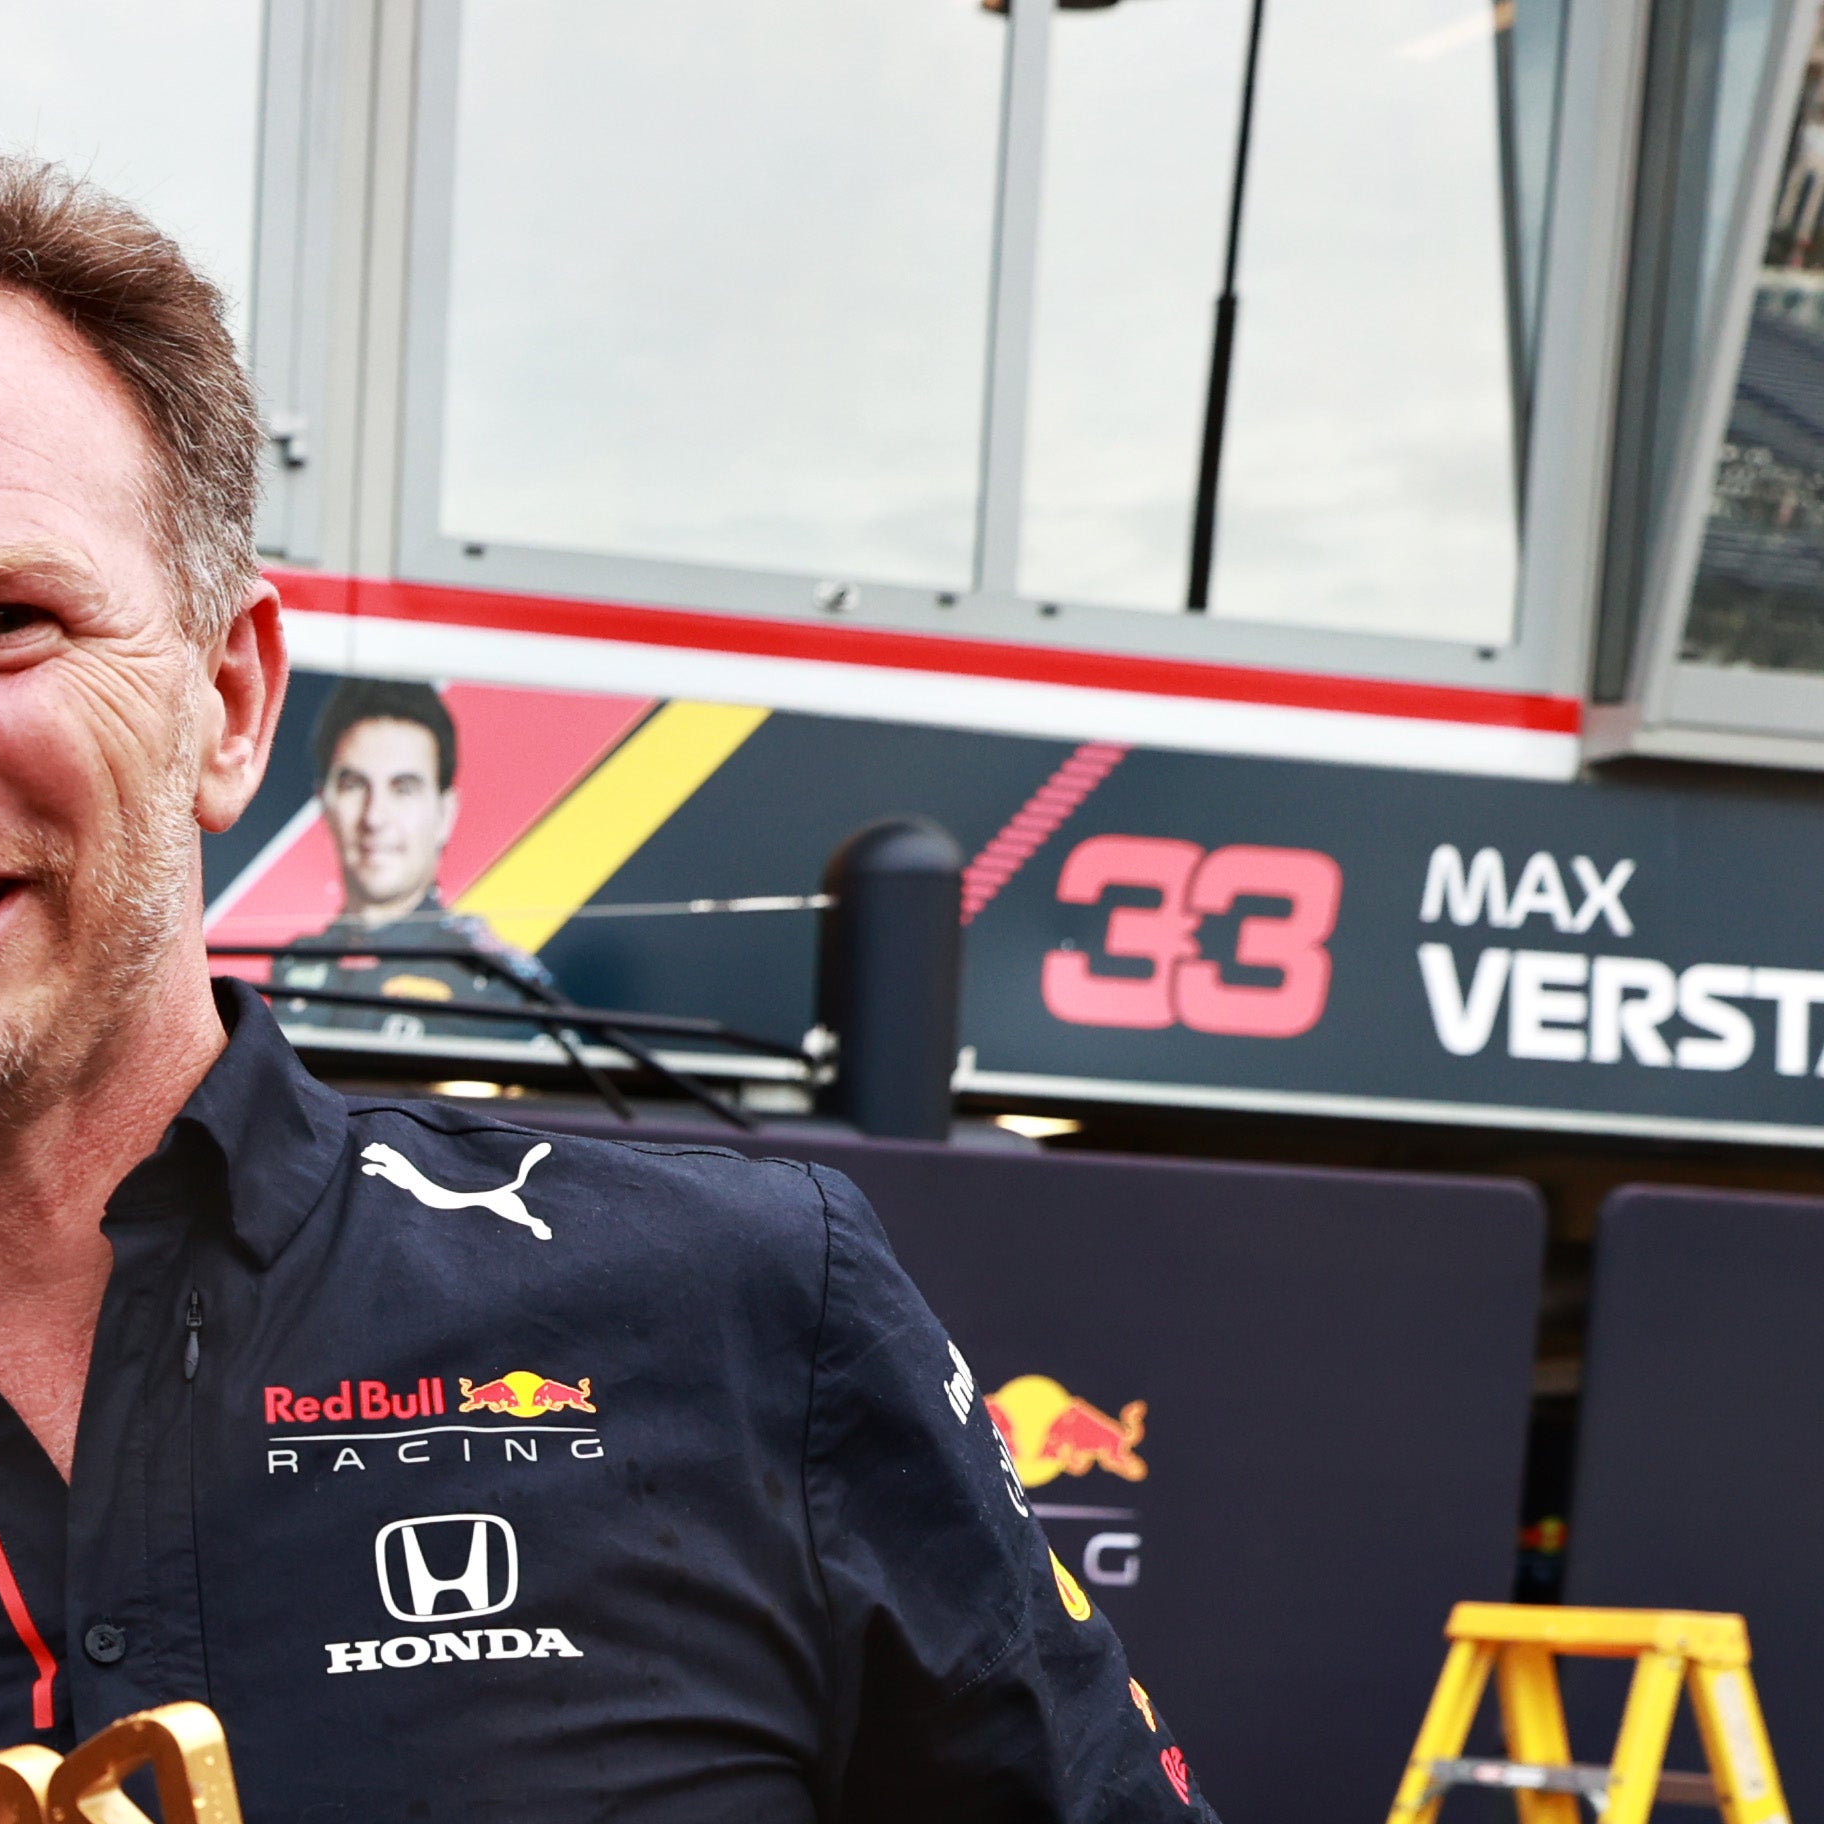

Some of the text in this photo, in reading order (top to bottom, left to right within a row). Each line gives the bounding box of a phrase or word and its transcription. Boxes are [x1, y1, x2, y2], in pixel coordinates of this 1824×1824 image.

[1417, 842, 1638, 938] MAX
[1040, 833, 1344, 1039] 33
[1416, 942, 1824, 1078] VERST
[263, 1376, 447, 1425] Red Bull
[266, 1437, 604, 1475] RACING
[324, 1627, 584, 1674] HONDA
